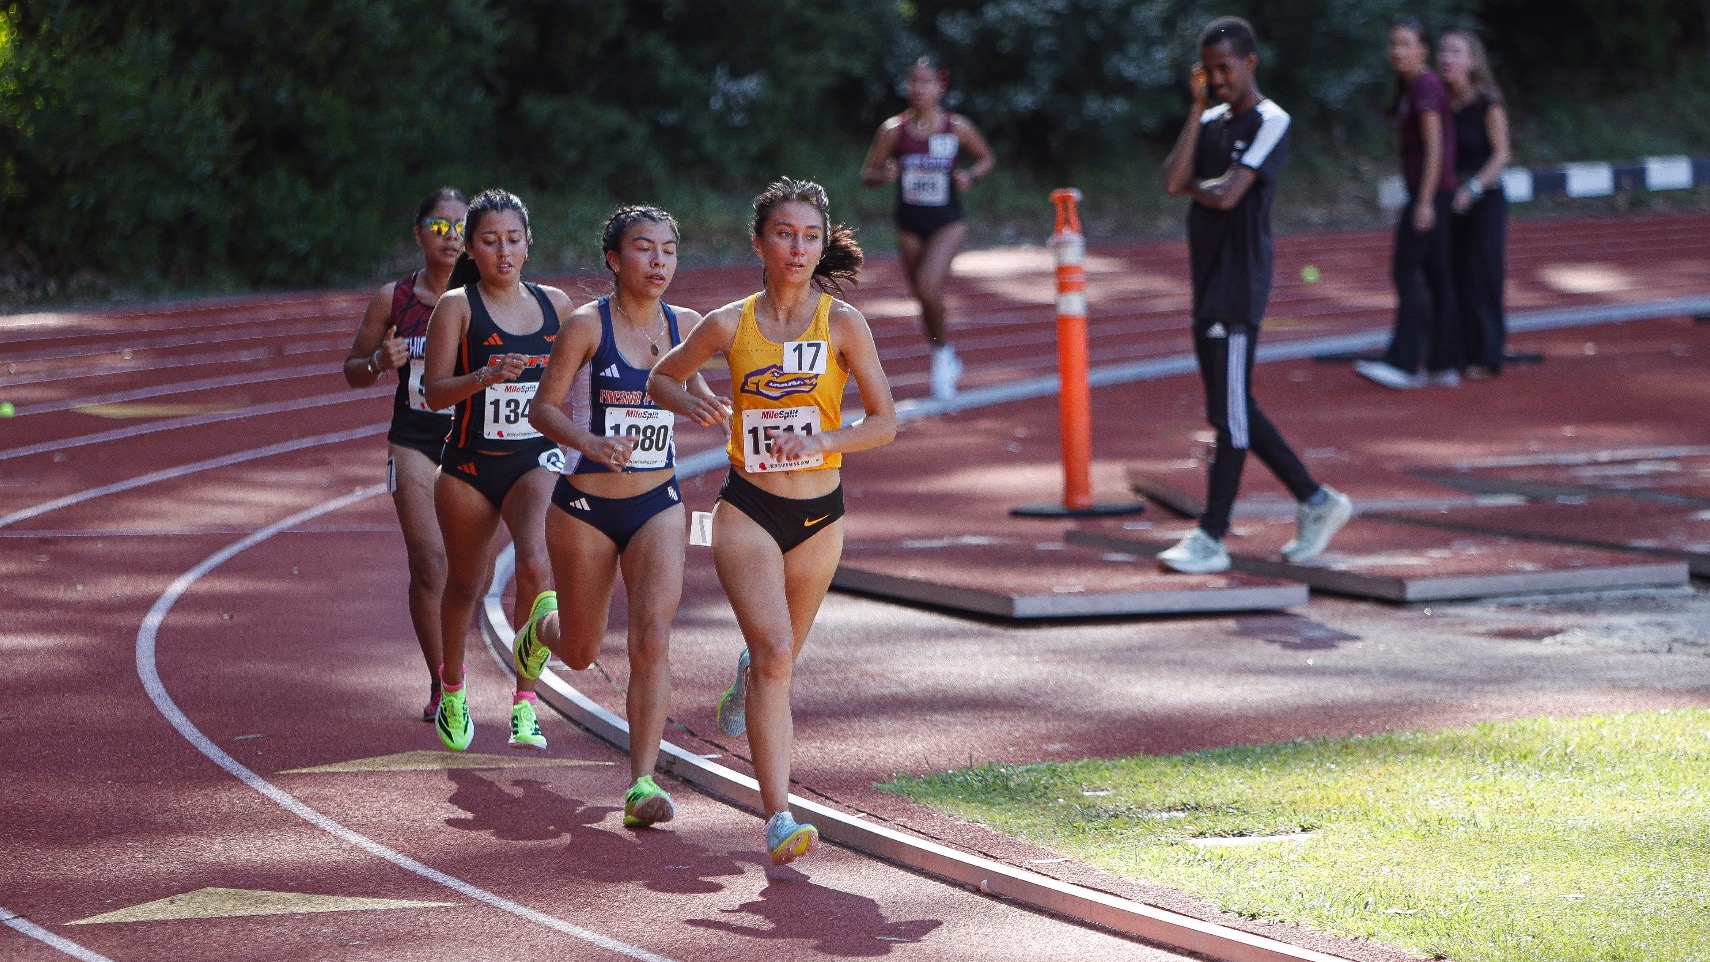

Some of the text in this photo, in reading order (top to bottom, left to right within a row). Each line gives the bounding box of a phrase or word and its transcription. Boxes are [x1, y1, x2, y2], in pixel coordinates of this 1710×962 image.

[793, 343, 821, 371] 17
[505, 385, 536, 394] MileSplit
[625, 410, 659, 420] MileSplit
[761, 409, 799, 420] MileSplit
